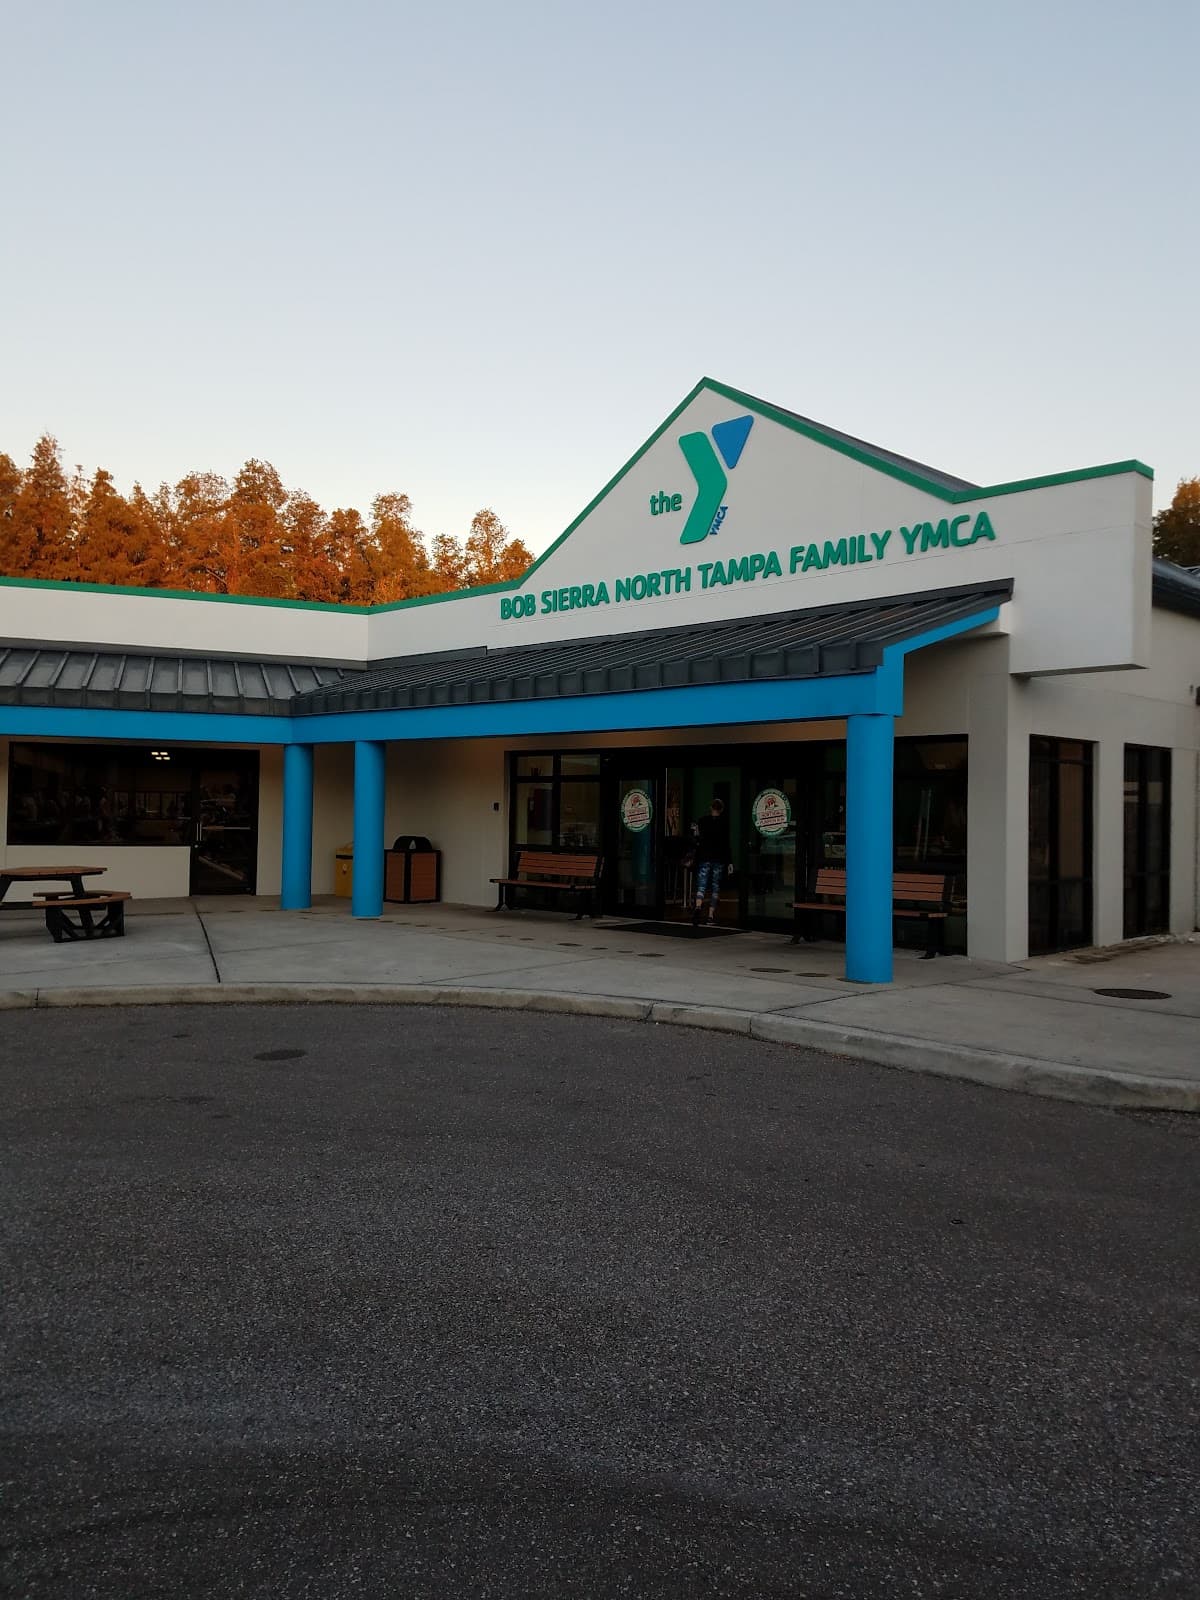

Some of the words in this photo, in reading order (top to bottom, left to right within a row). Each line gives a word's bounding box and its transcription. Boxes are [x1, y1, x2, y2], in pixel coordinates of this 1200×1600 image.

[650, 491, 682, 516] the
[709, 505, 729, 535] YMCA
[500, 594, 536, 620] BOB
[541, 581, 610, 615] SIERRA
[615, 567, 691, 602] NORTH
[697, 551, 783, 589] TAMPA
[789, 530, 892, 575] FAMILY
[899, 511, 996, 554] YMCA
